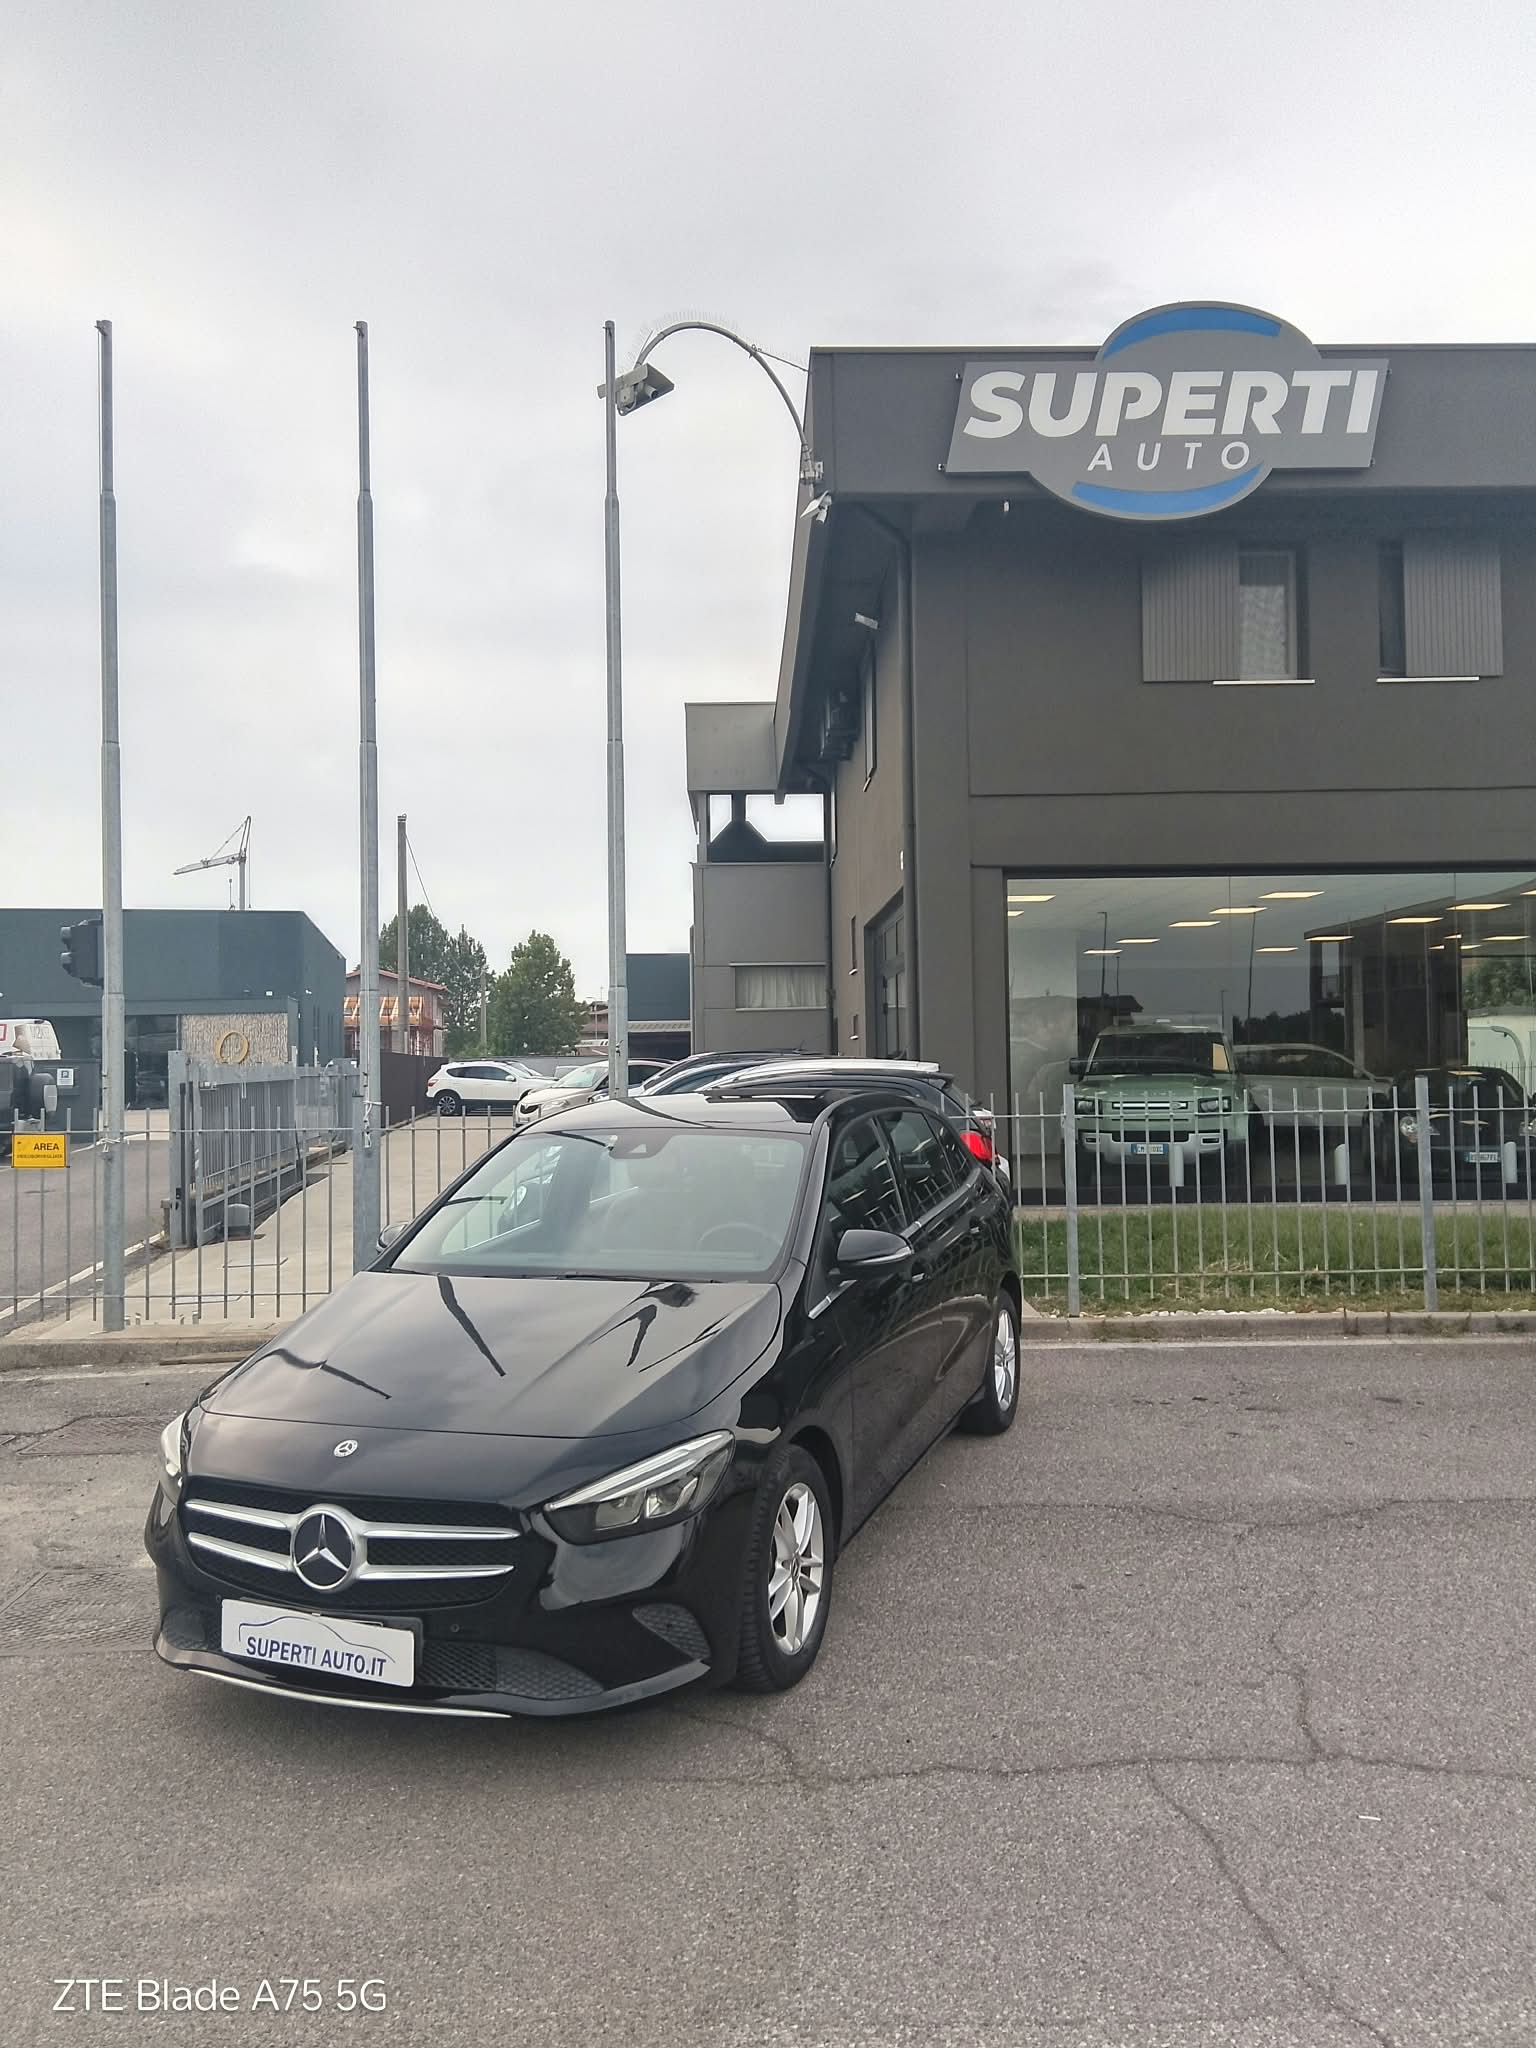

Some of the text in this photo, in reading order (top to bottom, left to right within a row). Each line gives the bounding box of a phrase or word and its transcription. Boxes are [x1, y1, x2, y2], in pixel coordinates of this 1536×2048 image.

[963, 369, 1379, 439] SUPERTI
[1087, 441, 1251, 472] AUTO
[33, 1143, 60, 1151] AREA
[246, 1636, 387, 1677] SUPERTI AUTO.IT
